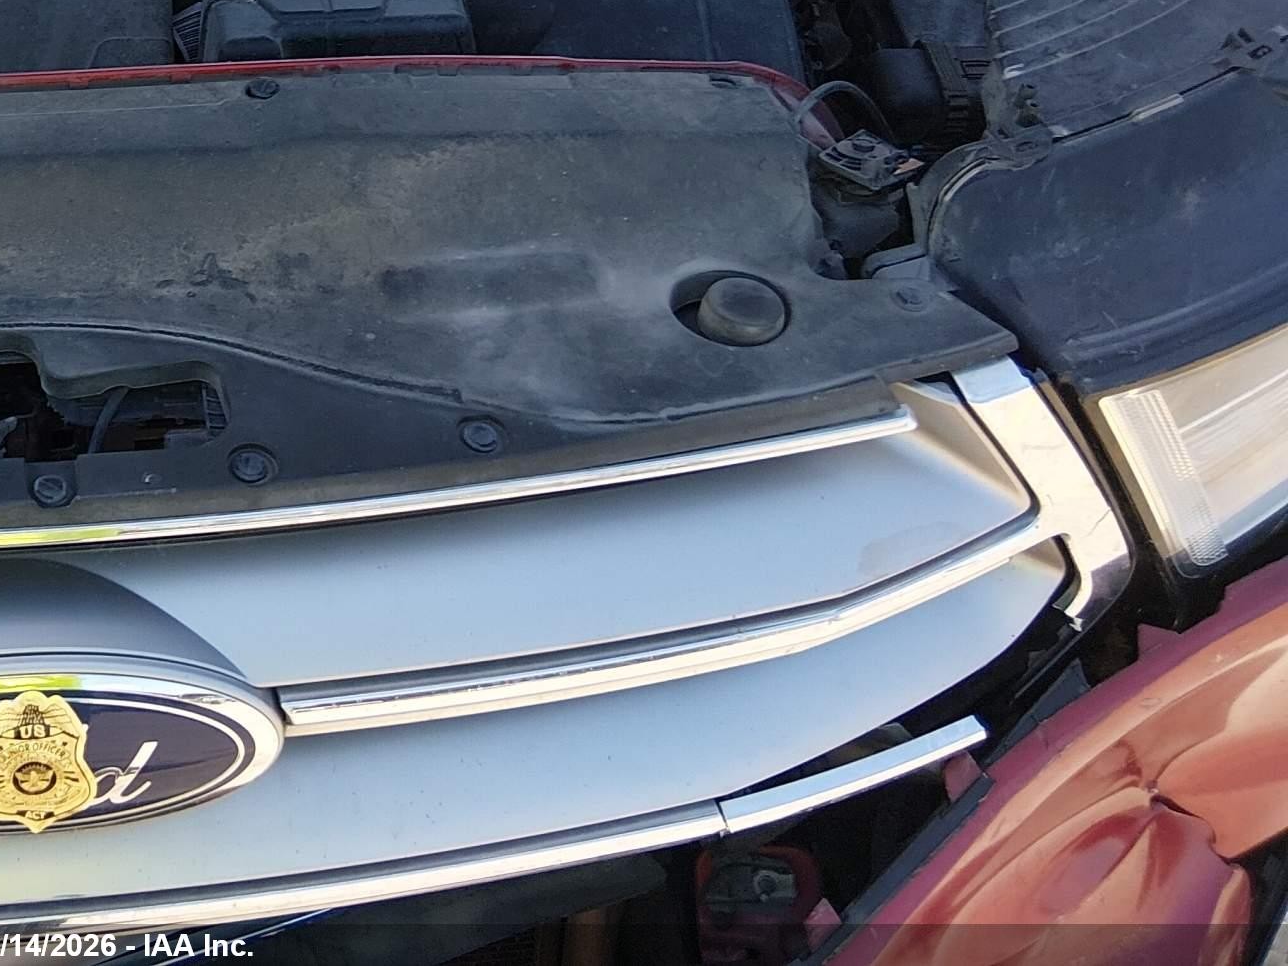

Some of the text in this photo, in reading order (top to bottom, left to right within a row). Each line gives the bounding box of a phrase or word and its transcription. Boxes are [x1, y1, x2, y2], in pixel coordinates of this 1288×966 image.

[19, 724, 46, 739] US
[32, 742, 66, 758] OFFICER
[24, 810, 47, 820] ACT
